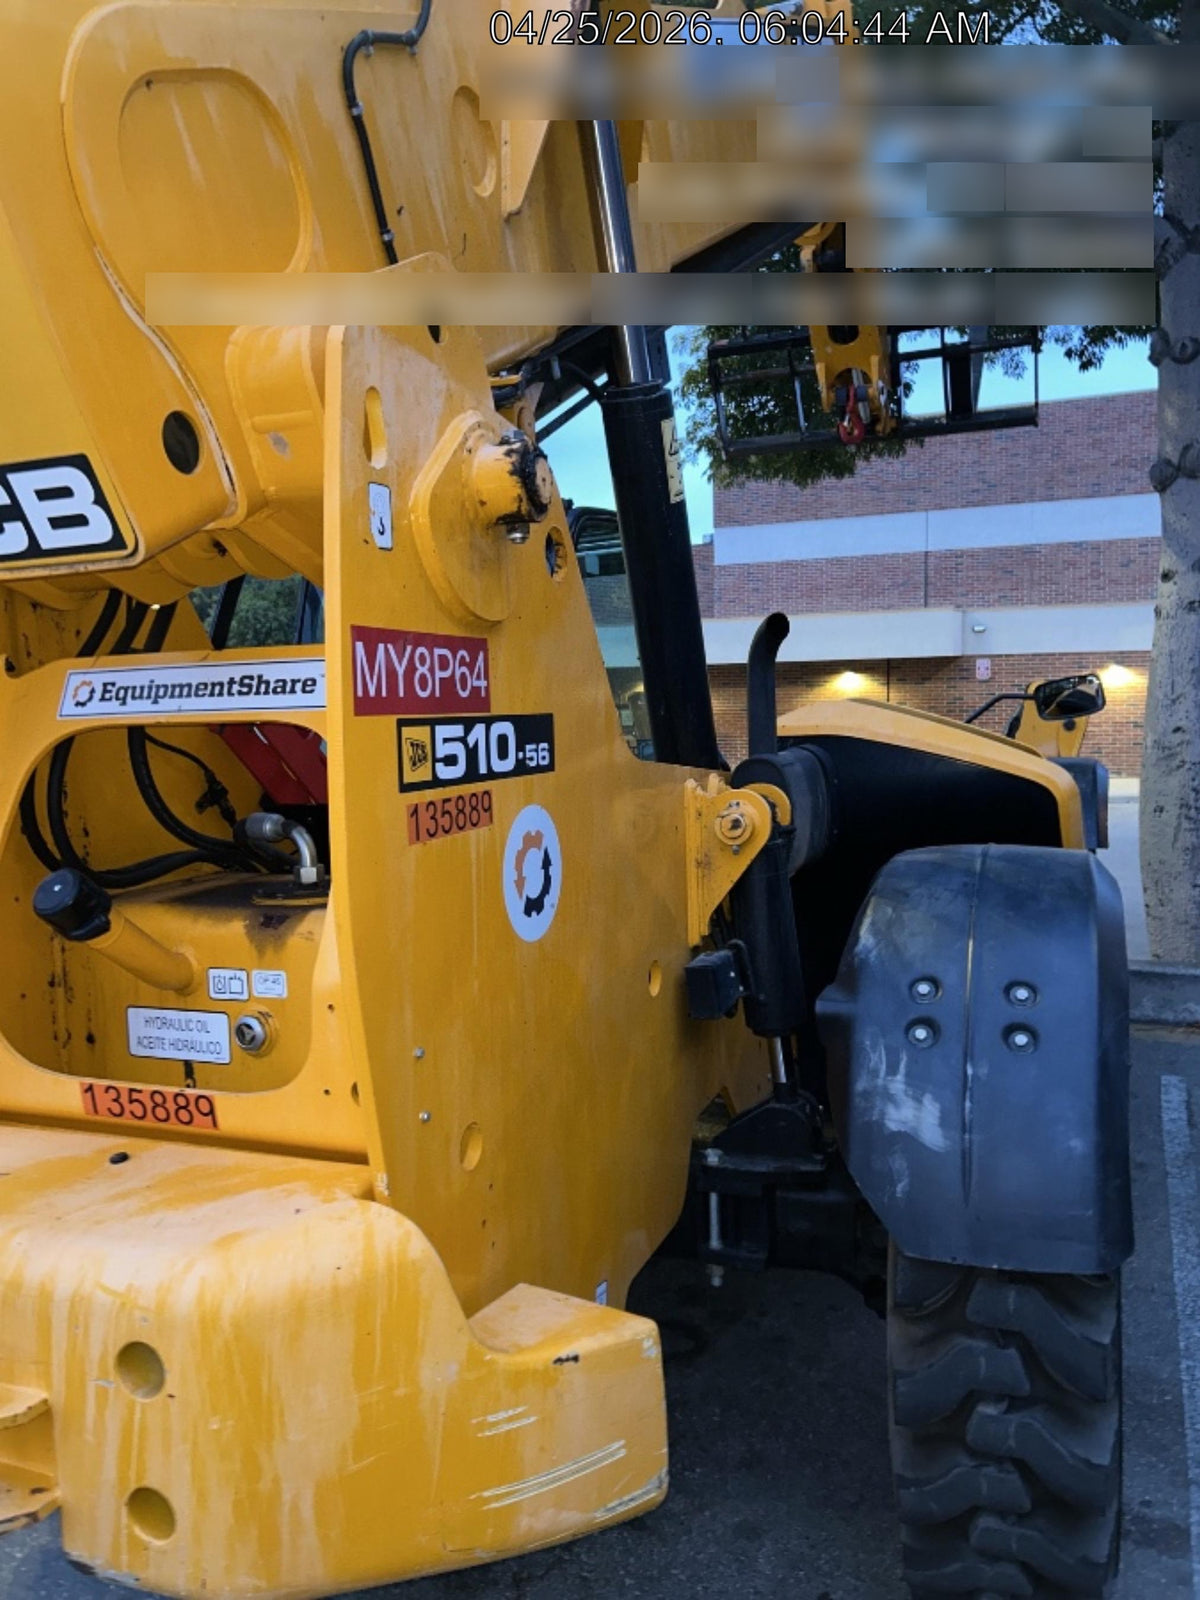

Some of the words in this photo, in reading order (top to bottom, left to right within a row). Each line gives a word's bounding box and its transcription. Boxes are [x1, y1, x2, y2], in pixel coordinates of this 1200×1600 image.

[98, 674, 317, 705] EquipmentShare
[355, 641, 488, 698] MY8P64
[410, 790, 493, 842] 135889
[143, 1016, 194, 1032] HYDRAULIC
[84, 1083, 217, 1128] 135889
